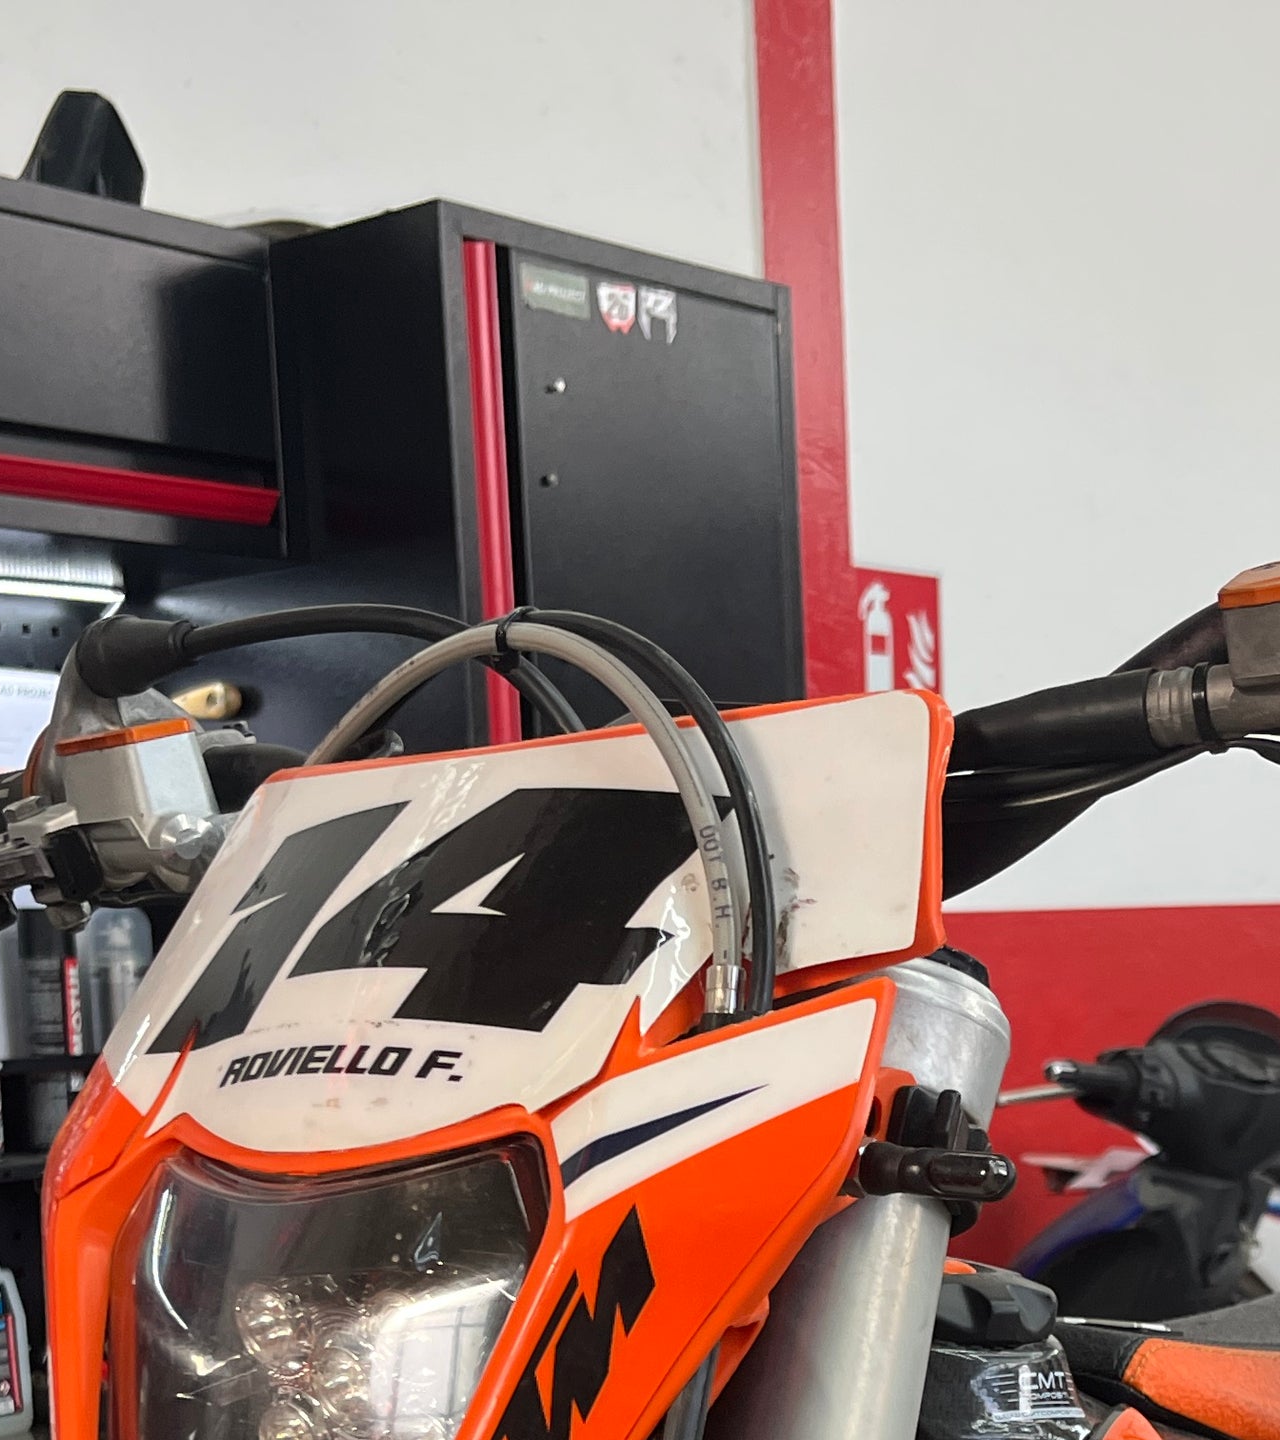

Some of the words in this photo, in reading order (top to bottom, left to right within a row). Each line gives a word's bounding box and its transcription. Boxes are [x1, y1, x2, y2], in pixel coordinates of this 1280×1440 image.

[145, 788, 732, 1055] 14
[220, 1045, 410, 1088] ROVIELLO
[418, 1051, 463, 1082] F.
